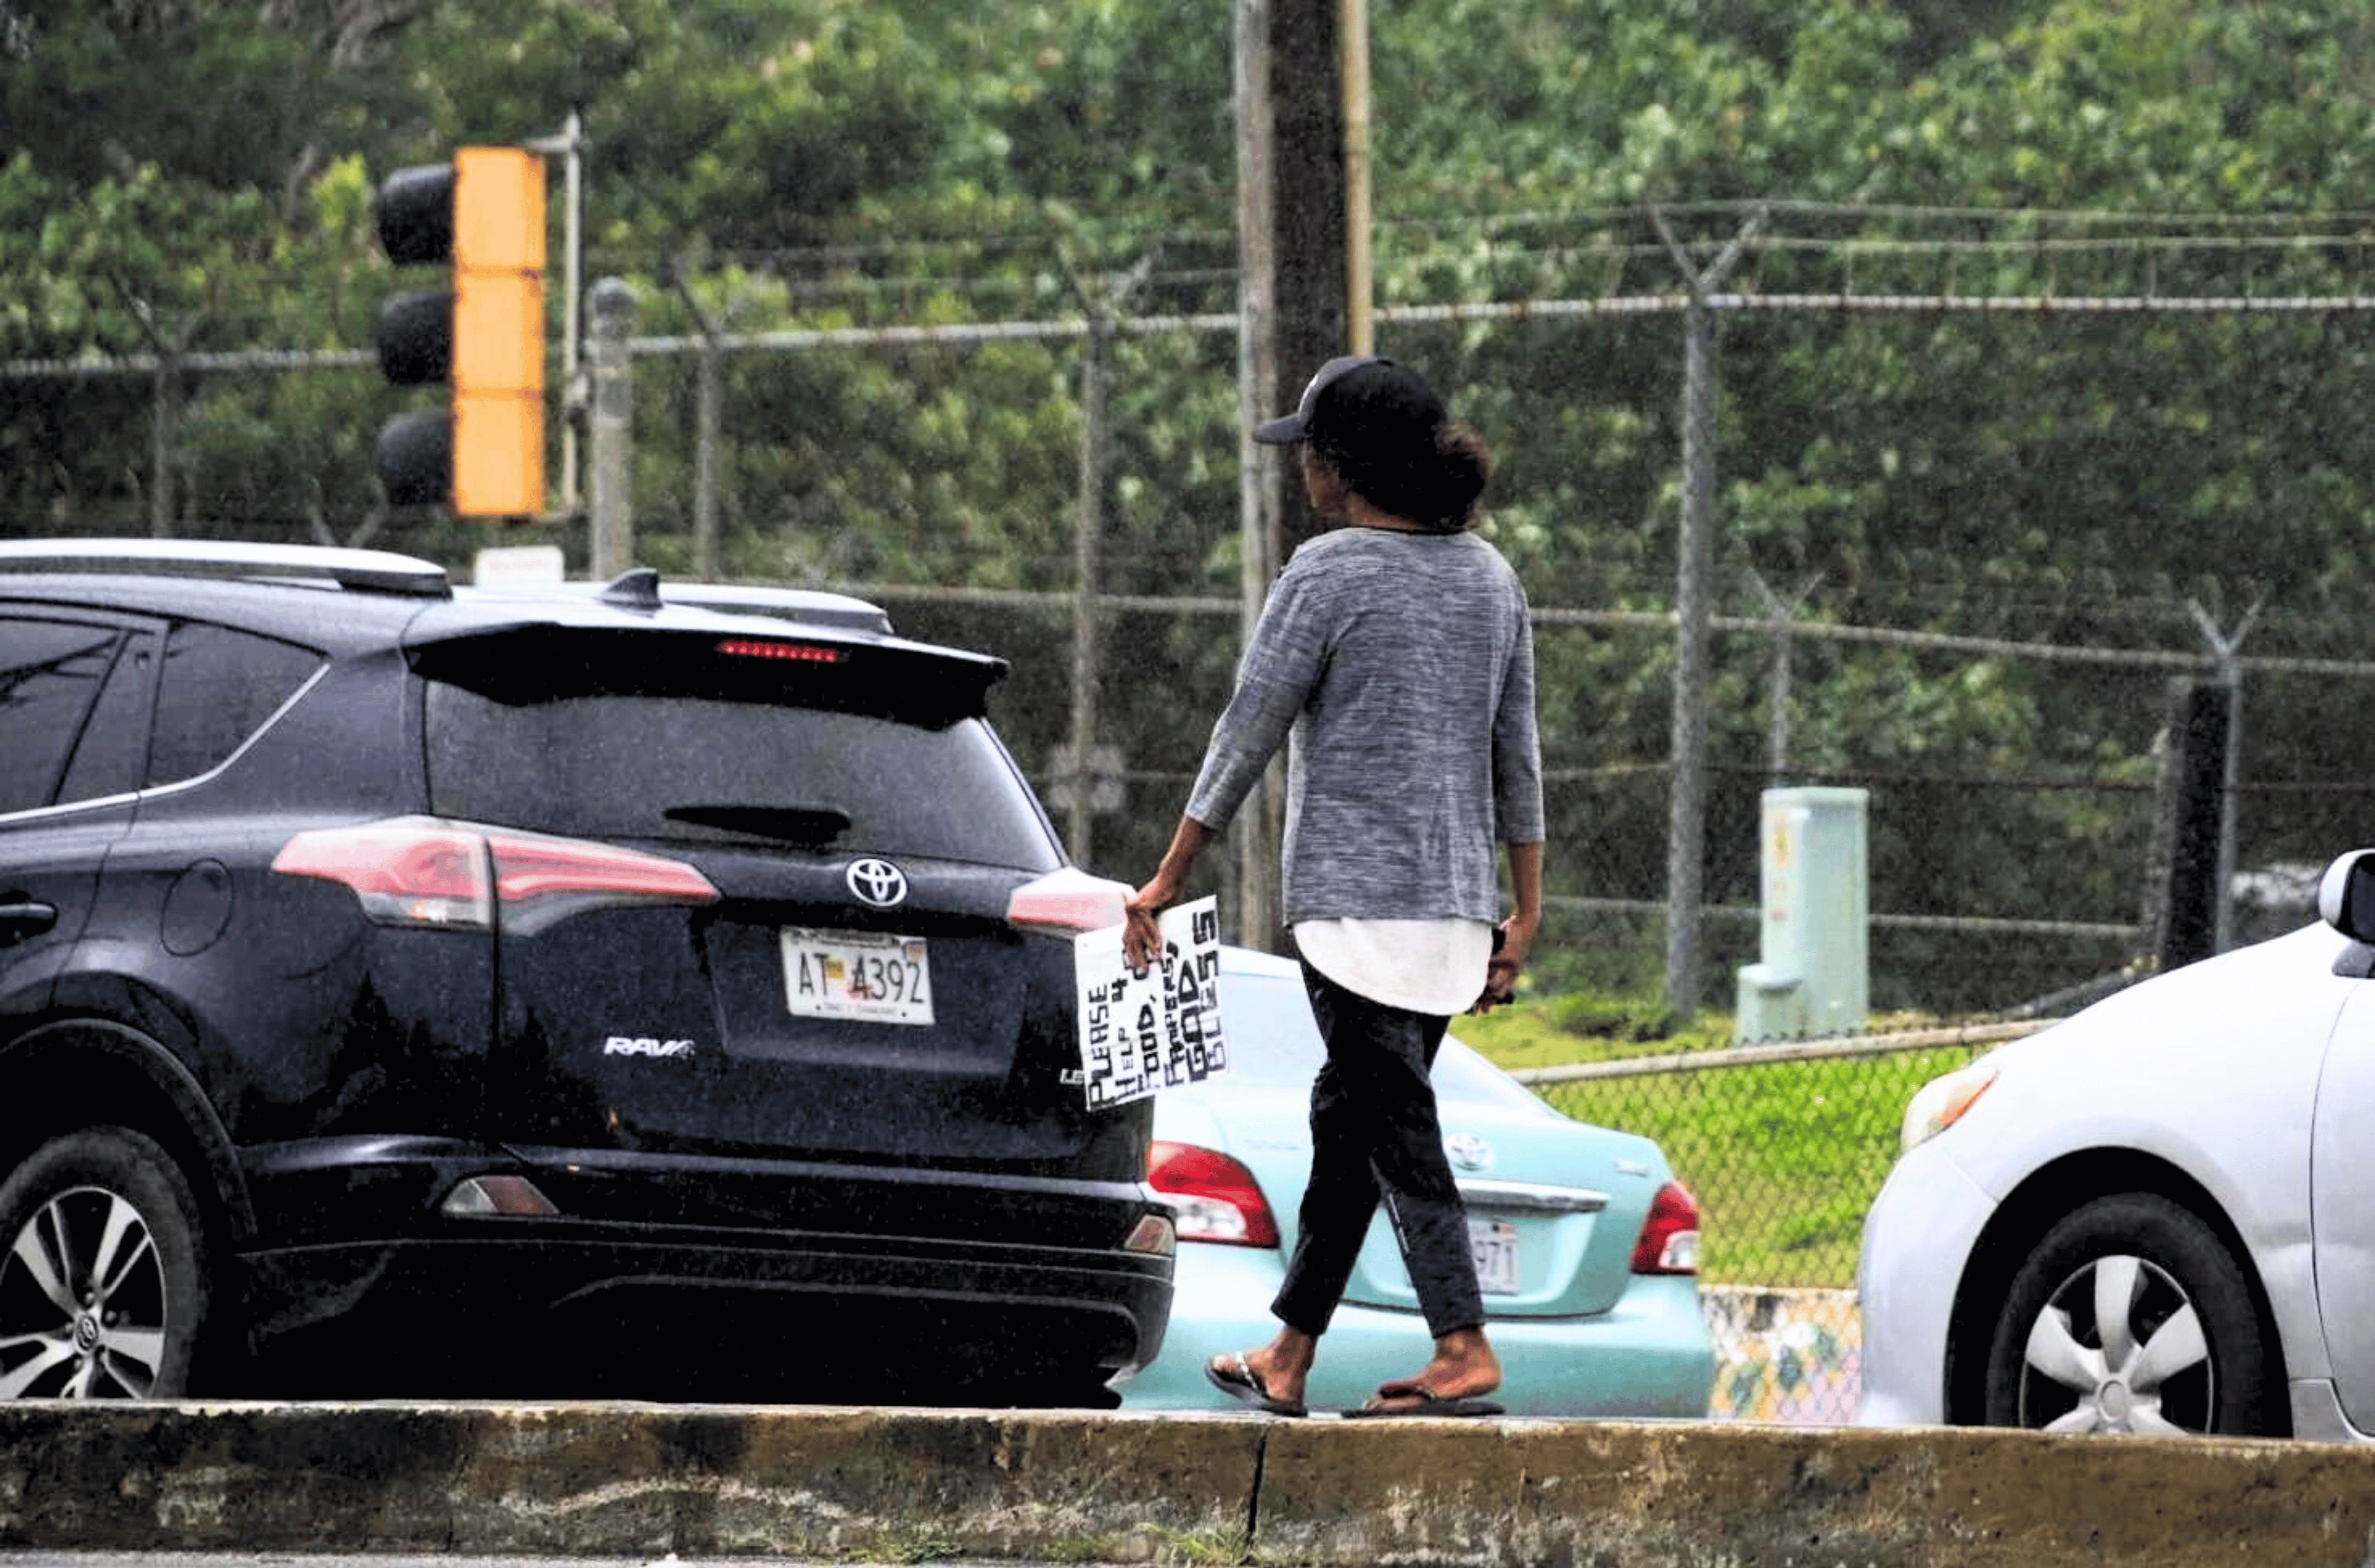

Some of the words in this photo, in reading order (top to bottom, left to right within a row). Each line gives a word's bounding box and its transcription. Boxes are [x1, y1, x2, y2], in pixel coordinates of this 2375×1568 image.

[799, 952, 829, 996] AT
[848, 954, 924, 1004] 4392
[1178, 959, 1209, 1082] GOD
[1192, 909, 1226, 1072] BLESS
[1088, 984, 1116, 1106] PLEASE
[1115, 1027, 1137, 1101] HELP
